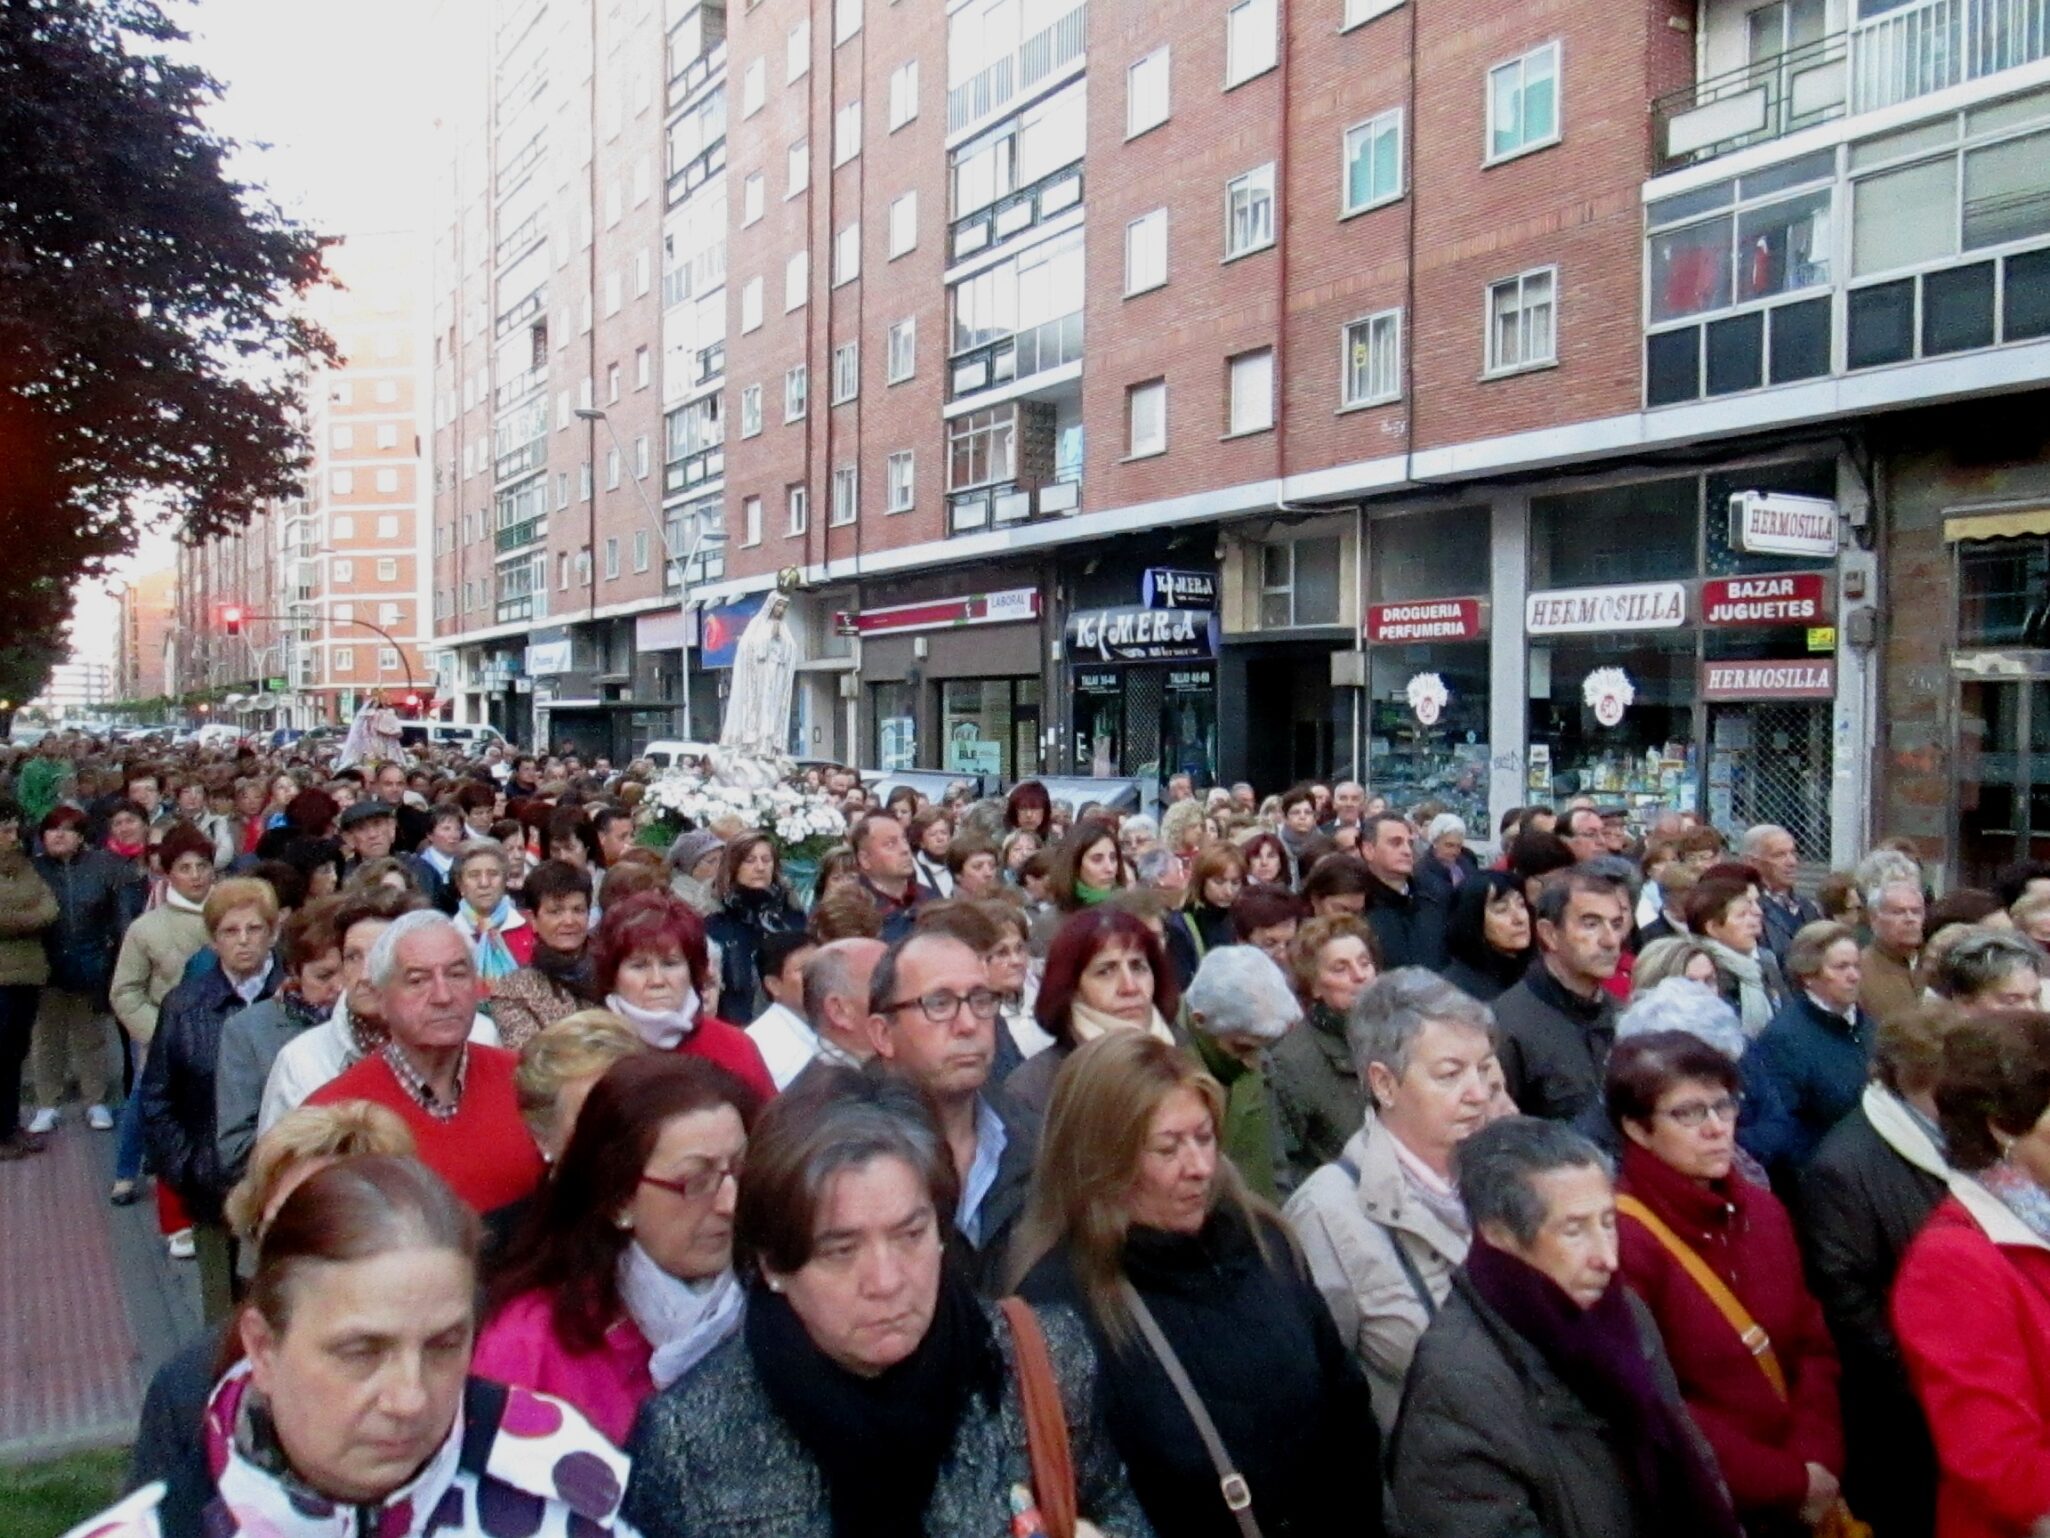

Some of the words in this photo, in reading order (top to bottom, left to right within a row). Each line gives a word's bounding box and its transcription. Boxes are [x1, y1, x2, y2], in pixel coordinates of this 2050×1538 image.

[1750, 508, 1834, 540] HERMOSILLA
[1728, 579, 1795, 599] BAZAR
[991, 593, 1025, 608] LABORAL
[1531, 591, 1682, 626] HERMOSILLA
[1709, 599, 1815, 621] JUGUETES
[1382, 603, 1462, 622] DROGUERIA
[1379, 621, 1465, 640] PERFUMERIA
[1708, 667, 1830, 689] HERMOSILLA
